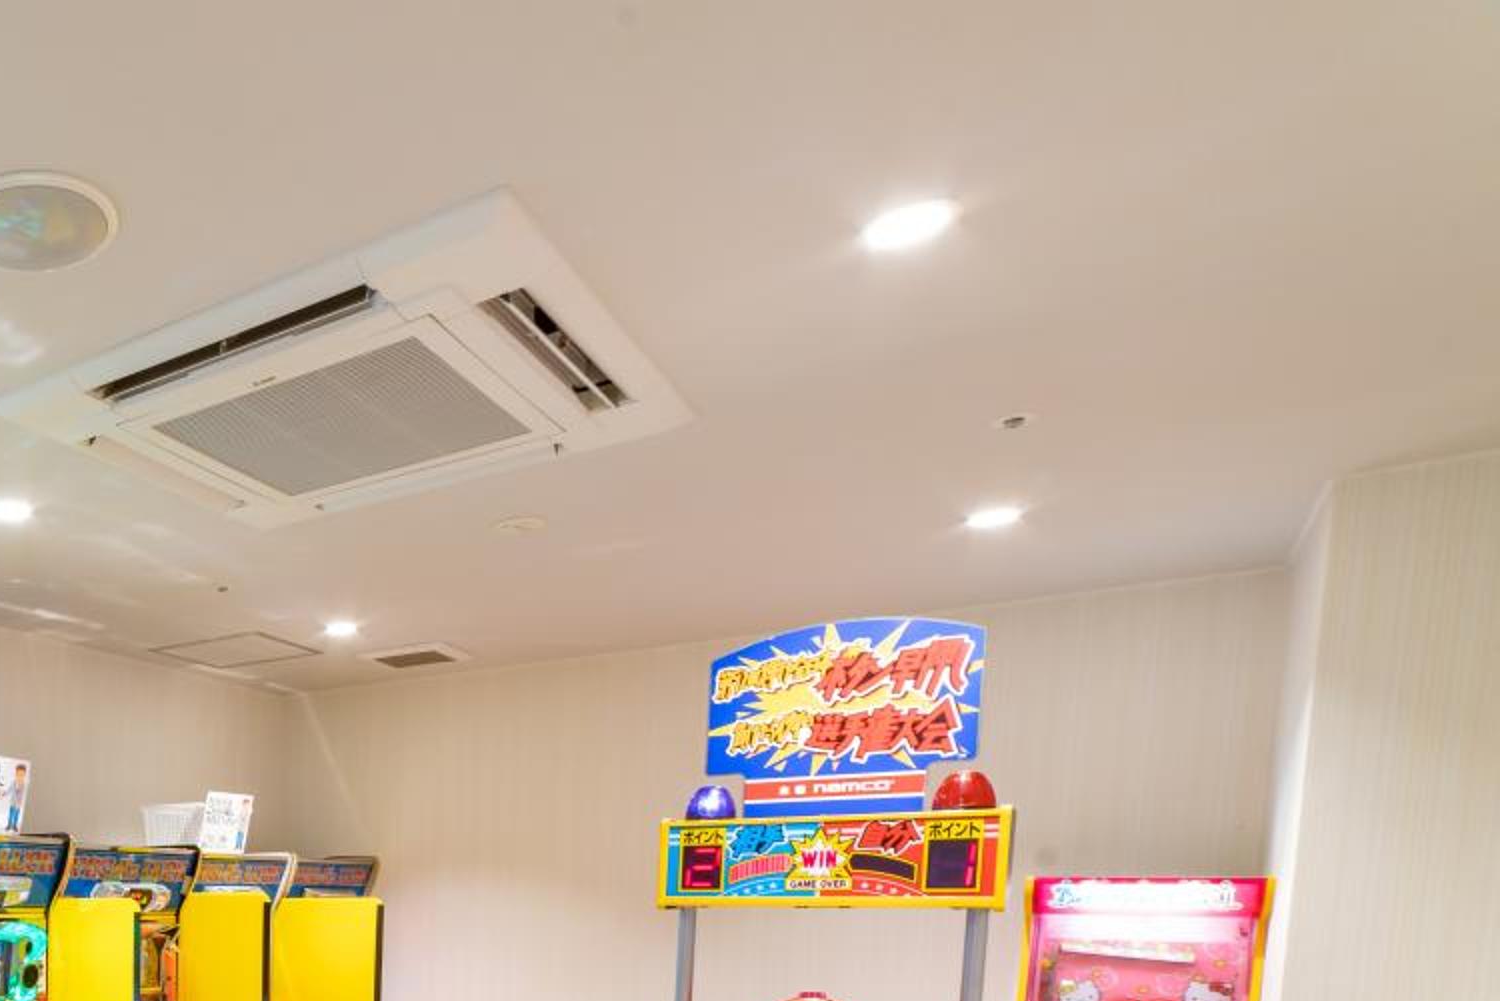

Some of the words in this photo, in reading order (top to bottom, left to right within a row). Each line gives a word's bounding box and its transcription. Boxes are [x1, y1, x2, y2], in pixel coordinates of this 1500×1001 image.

[814, 781, 891, 793] namco
[683, 830, 724, 844] ポイント
[929, 822, 980, 837] ポイント
[803, 850, 837, 867] WIN
[964, 844, 976, 886] 1
[686, 848, 721, 886] 2
[790, 880, 816, 888] GAME
[820, 880, 846, 888] OVER
